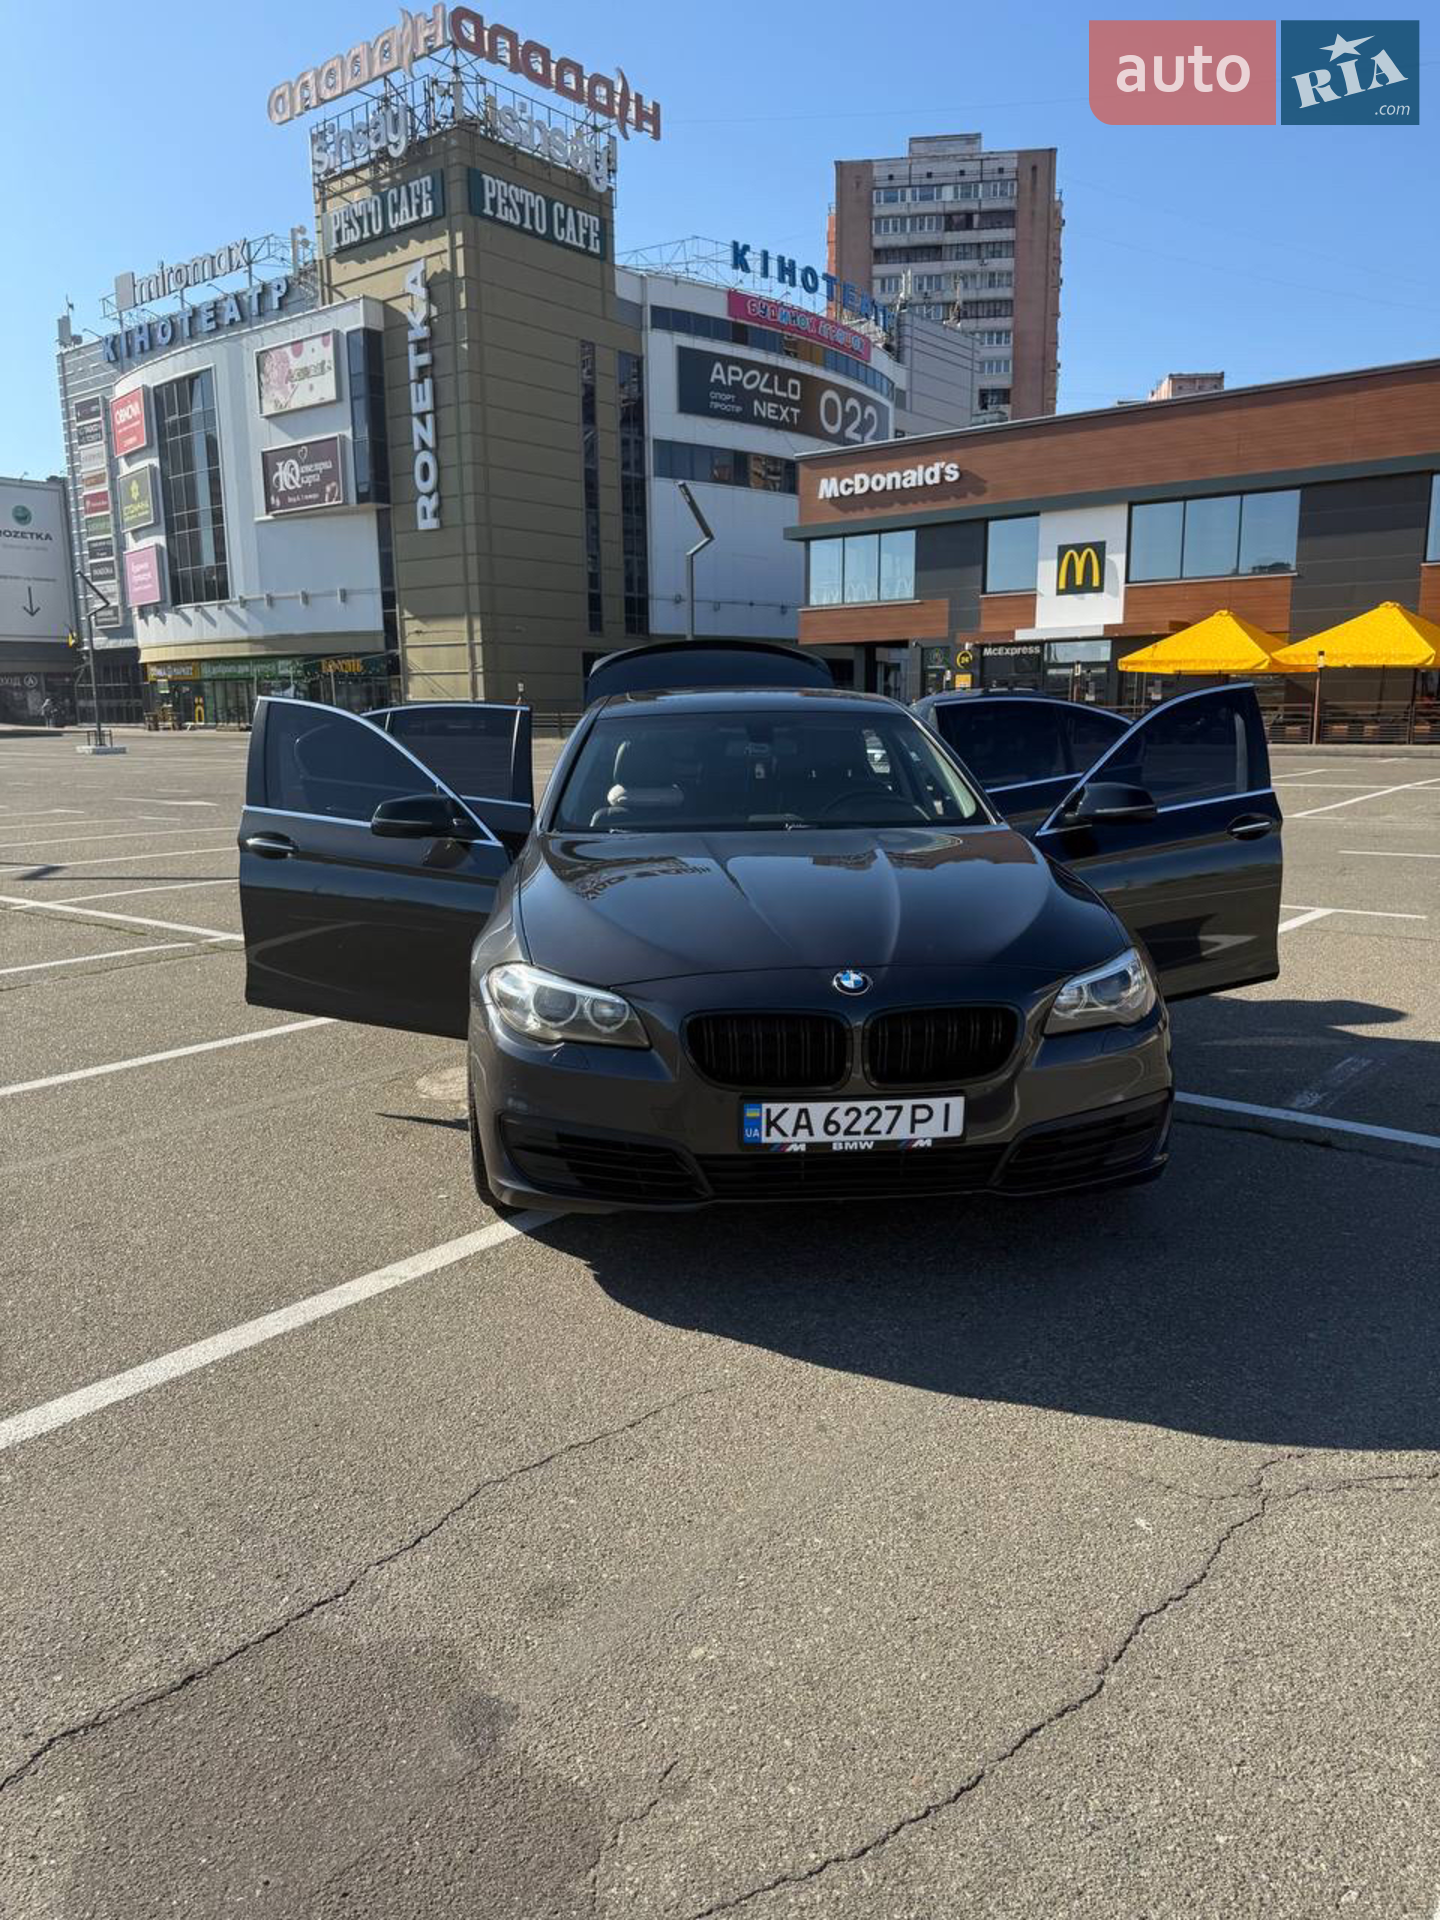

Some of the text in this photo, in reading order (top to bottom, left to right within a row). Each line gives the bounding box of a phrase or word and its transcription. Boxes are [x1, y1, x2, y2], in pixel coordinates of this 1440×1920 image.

[331, 175, 434, 249] PESTO CAFE
[480, 173, 601, 255] PESTO CAFE
[134, 238, 249, 305] miromax
[102, 278, 290, 362] КІНОТЕАТР
[405, 258, 442, 531] ROZETKA
[709, 361, 801, 401] APOLLO
[753, 400, 801, 425] NEXT
[818, 461, 961, 499] McDonald's
[0, 529, 53, 541] OZETKA
[983, 645, 1041, 657] McExpress
[744, 1128, 760, 1139] UA
[765, 1102, 951, 1138] KA 6227 PI
[832, 1141, 874, 1151] BMW
